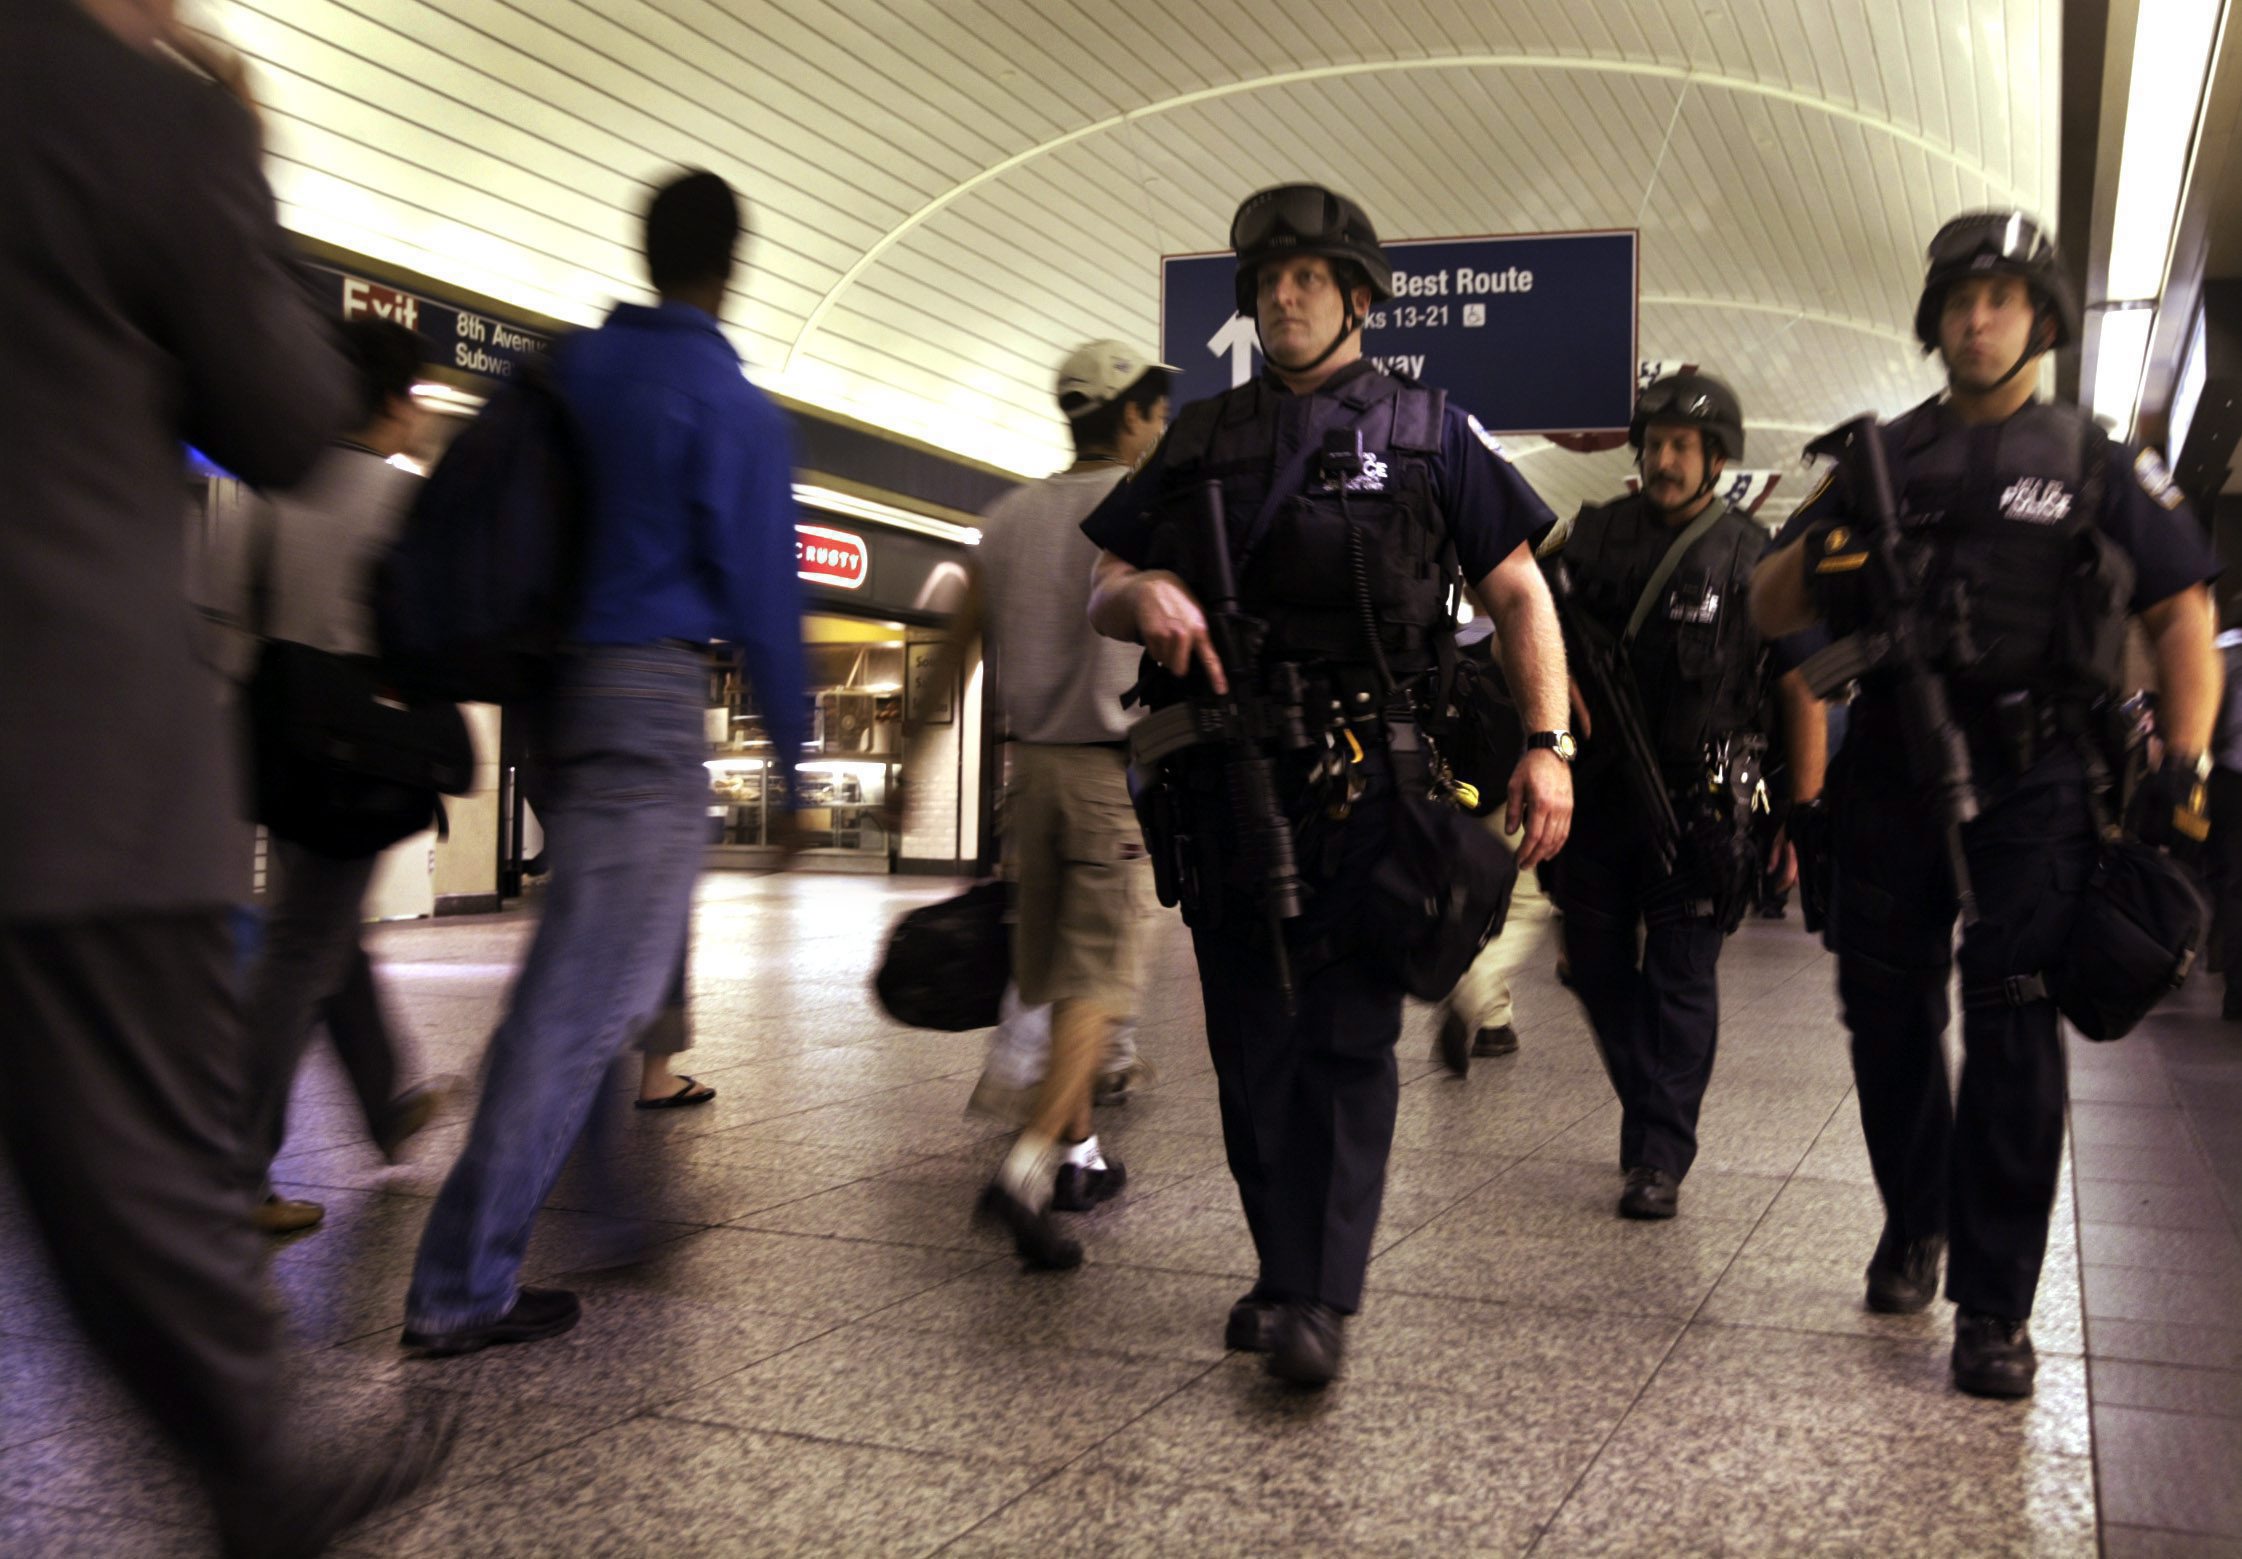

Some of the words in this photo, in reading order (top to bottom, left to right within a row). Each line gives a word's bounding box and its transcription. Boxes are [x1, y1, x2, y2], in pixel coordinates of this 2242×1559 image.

[1392, 269, 1449, 298] Best
[1456, 266, 1534, 295] Route
[456, 312, 486, 342] 8th
[1363, 311, 1387, 330] ks
[1393, 304, 1449, 329] 13-21
[455, 342, 514, 376] Subwa
[1371, 353, 1426, 381] way
